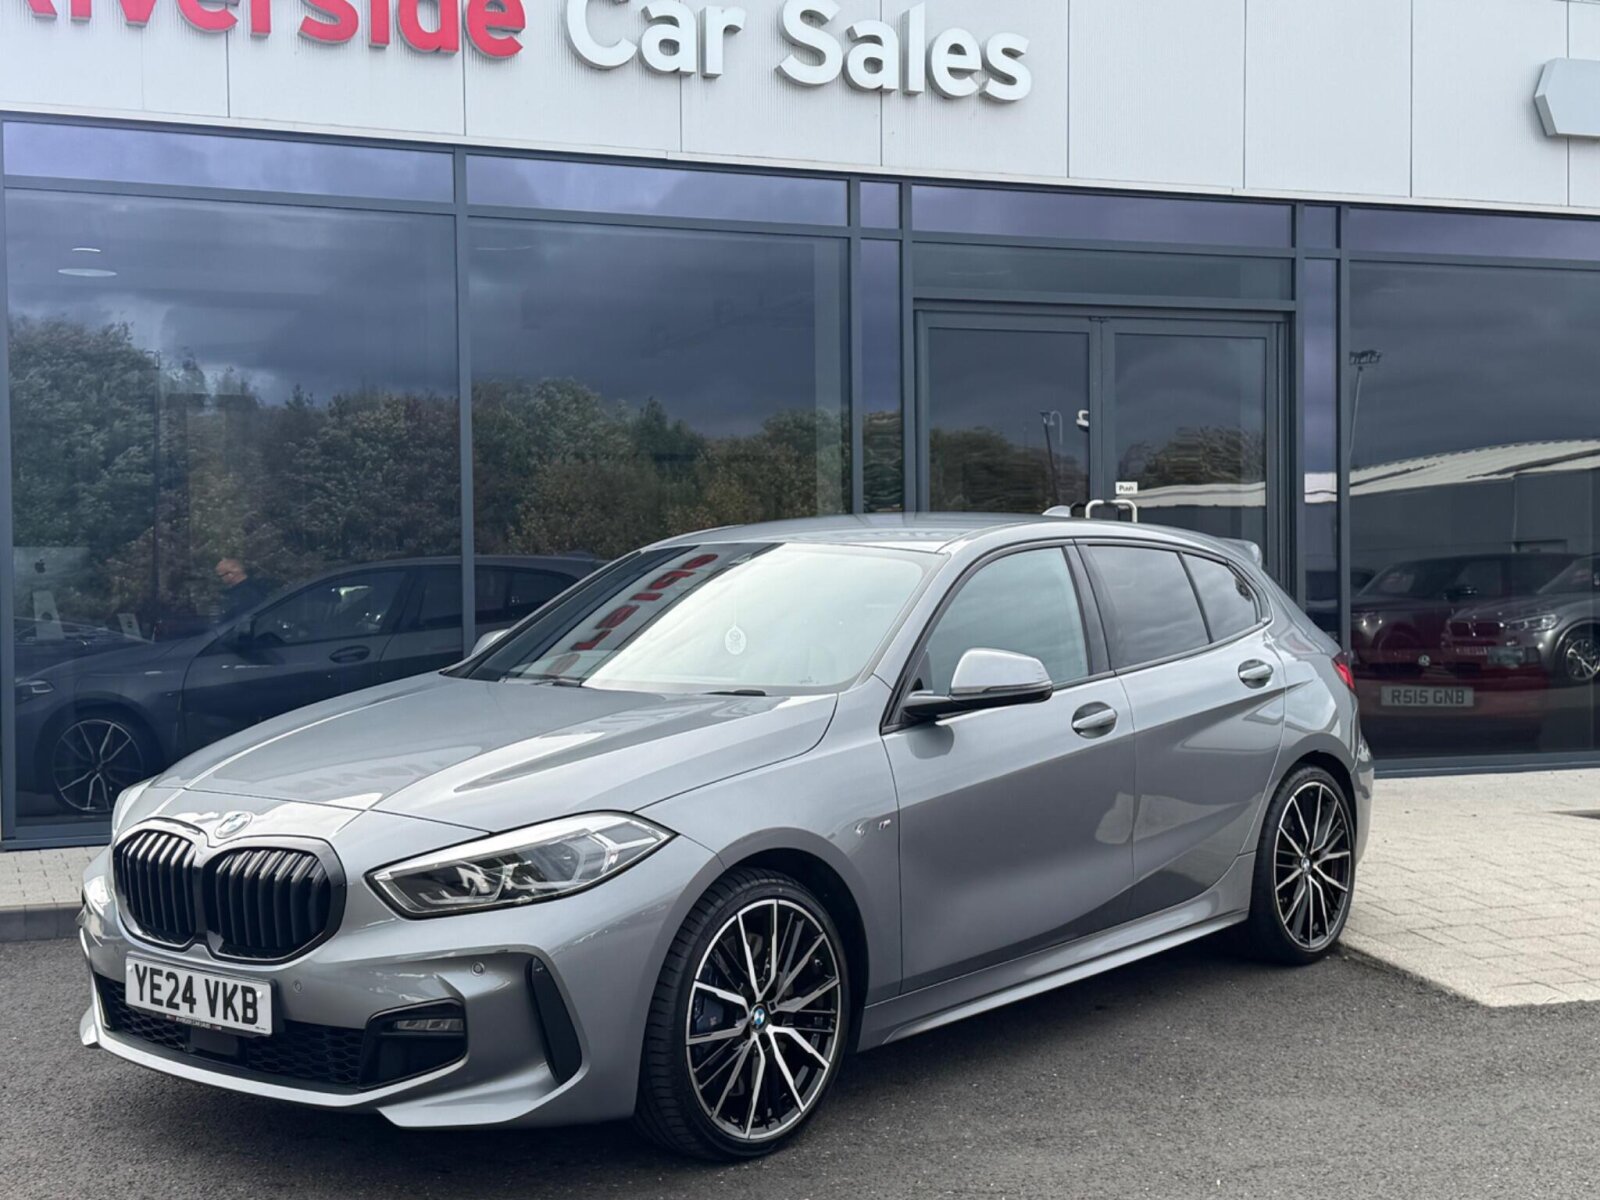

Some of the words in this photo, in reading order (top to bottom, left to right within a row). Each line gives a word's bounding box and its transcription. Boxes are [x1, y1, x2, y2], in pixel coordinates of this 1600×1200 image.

[25, 0, 525, 58] rside
[566, 0, 746, 79] Car
[775, 0, 1032, 102] Sales
[1433, 689, 1466, 705] GNB
[134, 963, 197, 1014] YE24
[204, 978, 258, 1025] VKB
